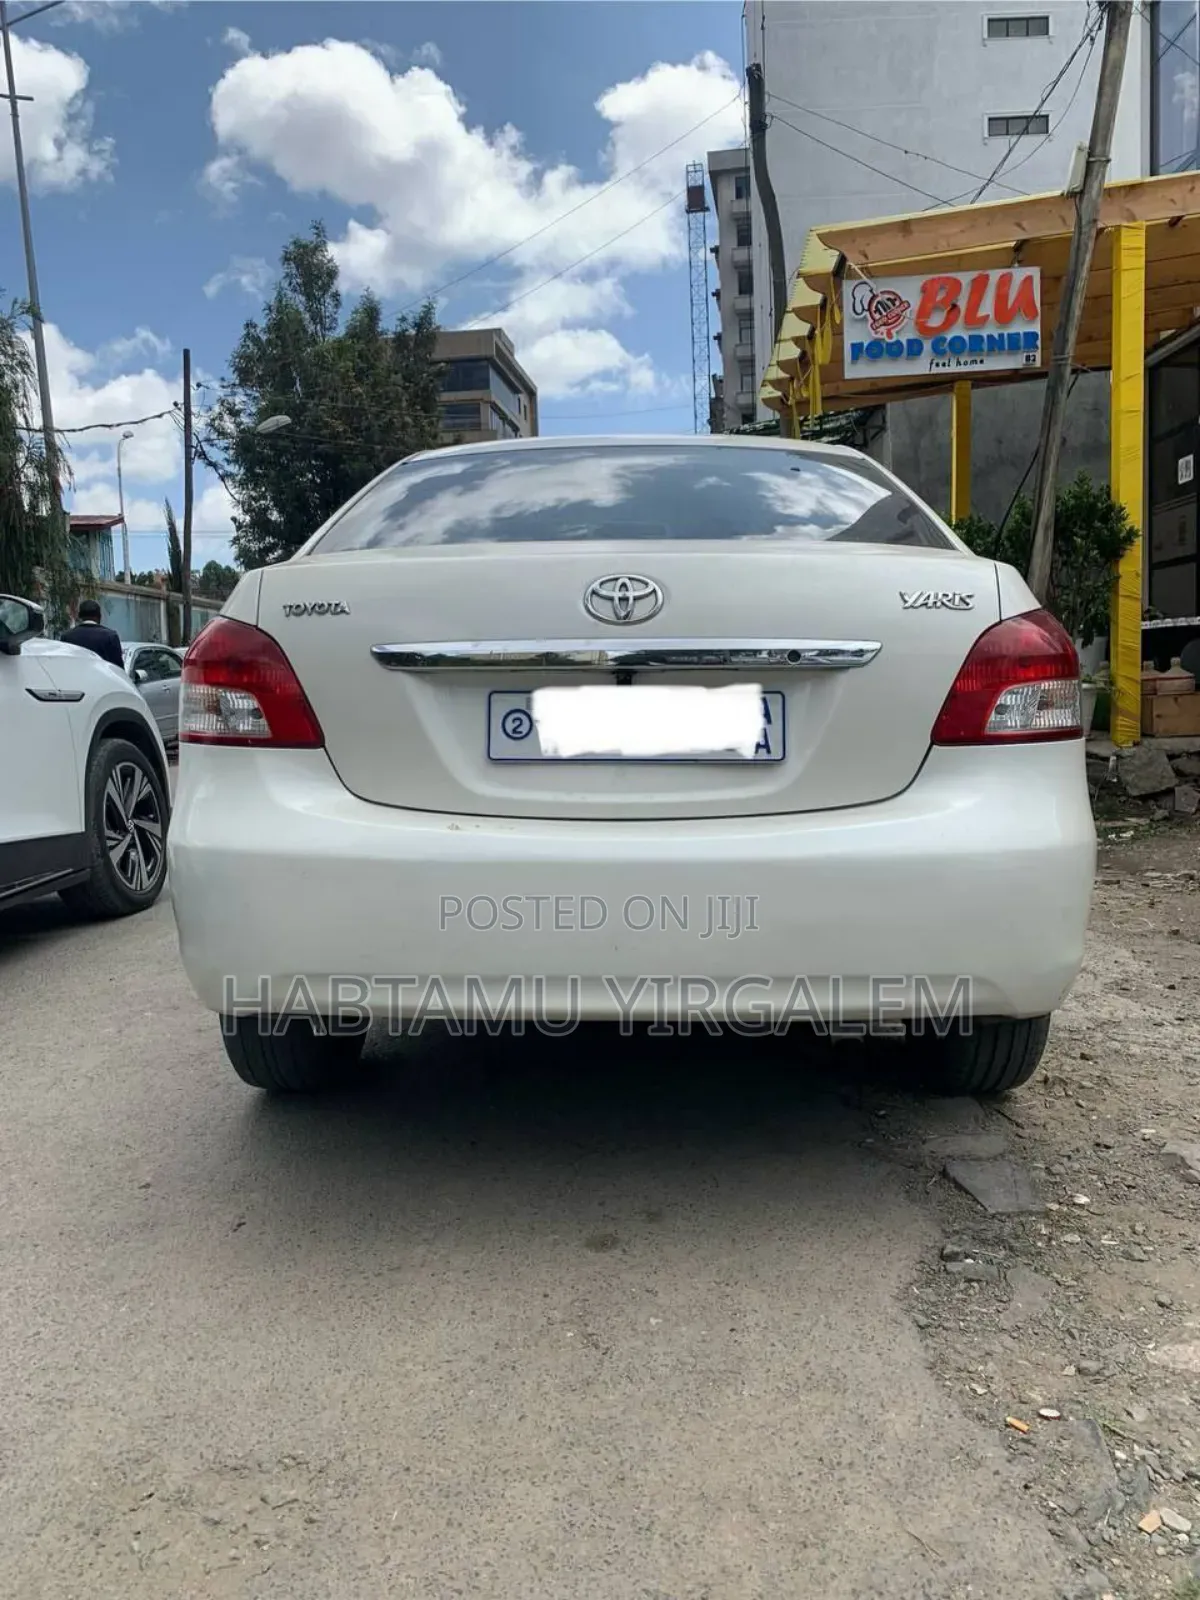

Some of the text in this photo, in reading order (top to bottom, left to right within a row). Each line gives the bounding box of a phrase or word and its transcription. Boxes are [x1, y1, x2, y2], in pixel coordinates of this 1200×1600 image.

[914, 272, 1039, 337] BLU
[850, 331, 1039, 364] FOOD CORNER
[929, 357, 985, 372] feel home
[282, 601, 351, 618] TOYOTA
[899, 591, 975, 611] YARIS
[511, 716, 524, 735] 2
